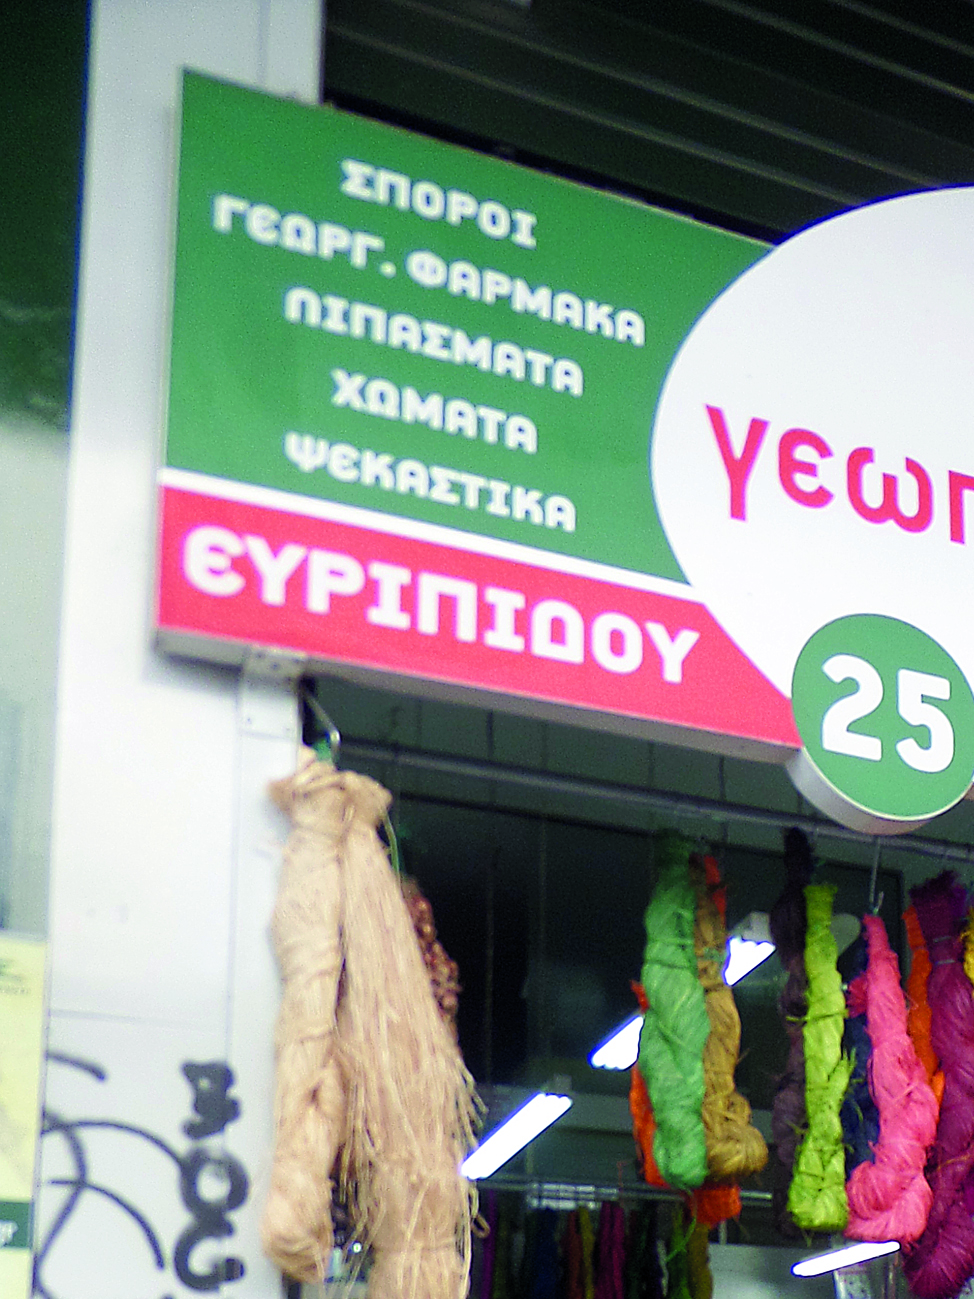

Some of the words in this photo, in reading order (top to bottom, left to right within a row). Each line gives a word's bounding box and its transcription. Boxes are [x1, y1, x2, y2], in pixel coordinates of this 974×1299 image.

[340, 158, 538, 248] ΣΠΟΡΟΙ
[212, 194, 396, 278] ΓΕΩΡΓ.
[406, 250, 646, 346] ΦΑΡΜΑΚΑ
[284, 287, 585, 397] ΛΙΠΑΣΜΑΤΑ
[331, 368, 538, 454] ΧΩΜΑΤΑ
[284, 431, 577, 532] ΨΕΚΑΣΤΙΚΑ
[183, 524, 700, 684] ΕΥΡΙΠΙΔΟΥ
[820, 652, 955, 774] 25
